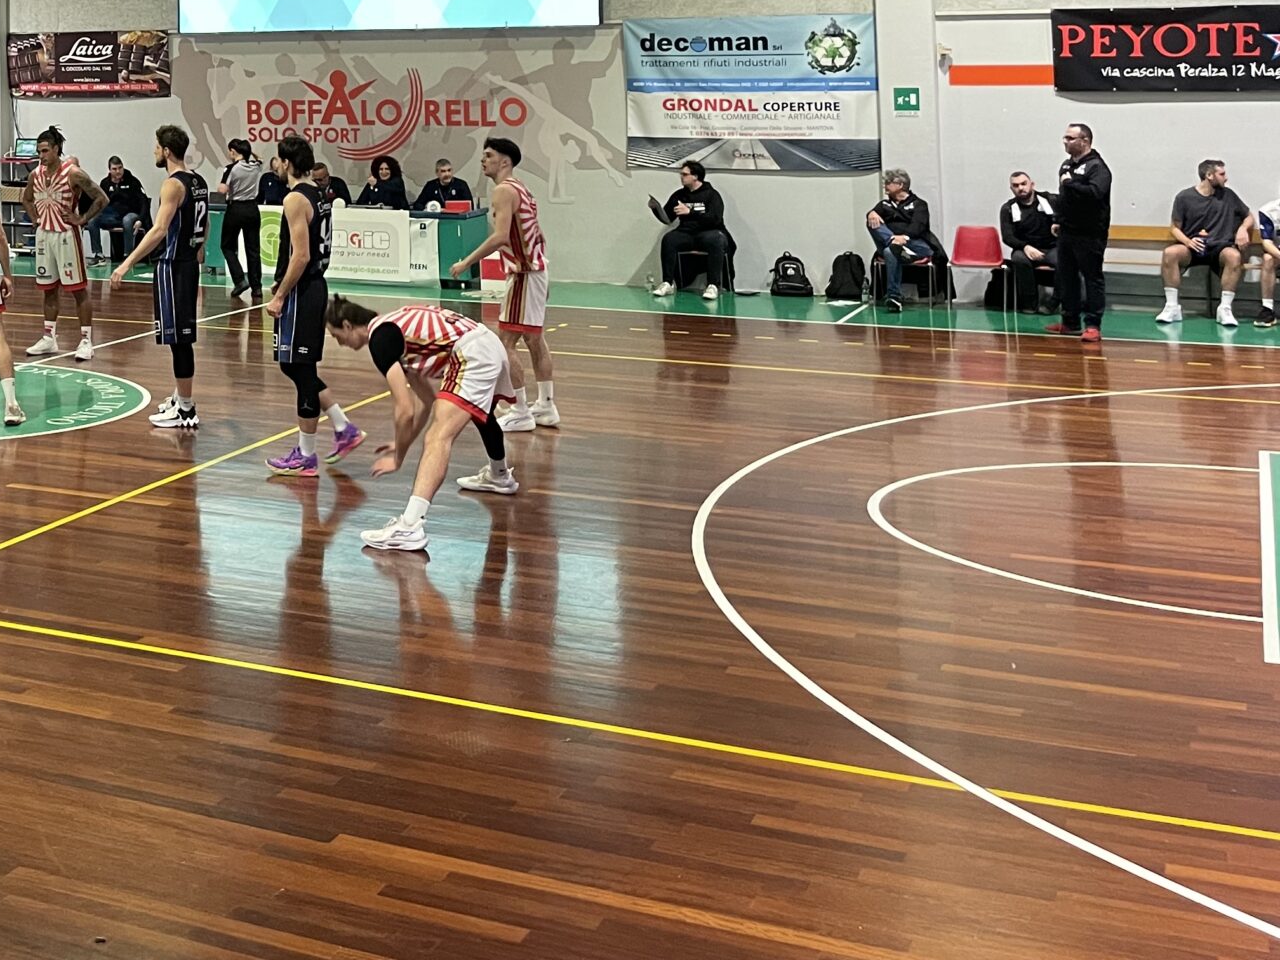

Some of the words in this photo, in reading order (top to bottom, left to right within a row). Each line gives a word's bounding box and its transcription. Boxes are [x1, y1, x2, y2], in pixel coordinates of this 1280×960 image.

[1057, 23, 1261, 57] PEYOTE
[59, 37, 114, 62] Laica
[641, 58, 700, 68] trattamenti
[704, 57, 731, 67] rifiuti
[734, 57, 787, 67] industriali
[1101, 66, 1120, 78] via
[1123, 66, 1175, 77] cascina
[1177, 62, 1228, 77] Peralza
[1232, 65, 1246, 76] 12
[662, 98, 759, 112] GRONDAL
[763, 101, 840, 113] COPERTURE
[664, 113, 712, 121] INDUSTRIALE
[788, 112, 841, 120] ARTIGIANALE
[303, 127, 360, 144] SPORT
[410, 263, 428, 271] REEN
